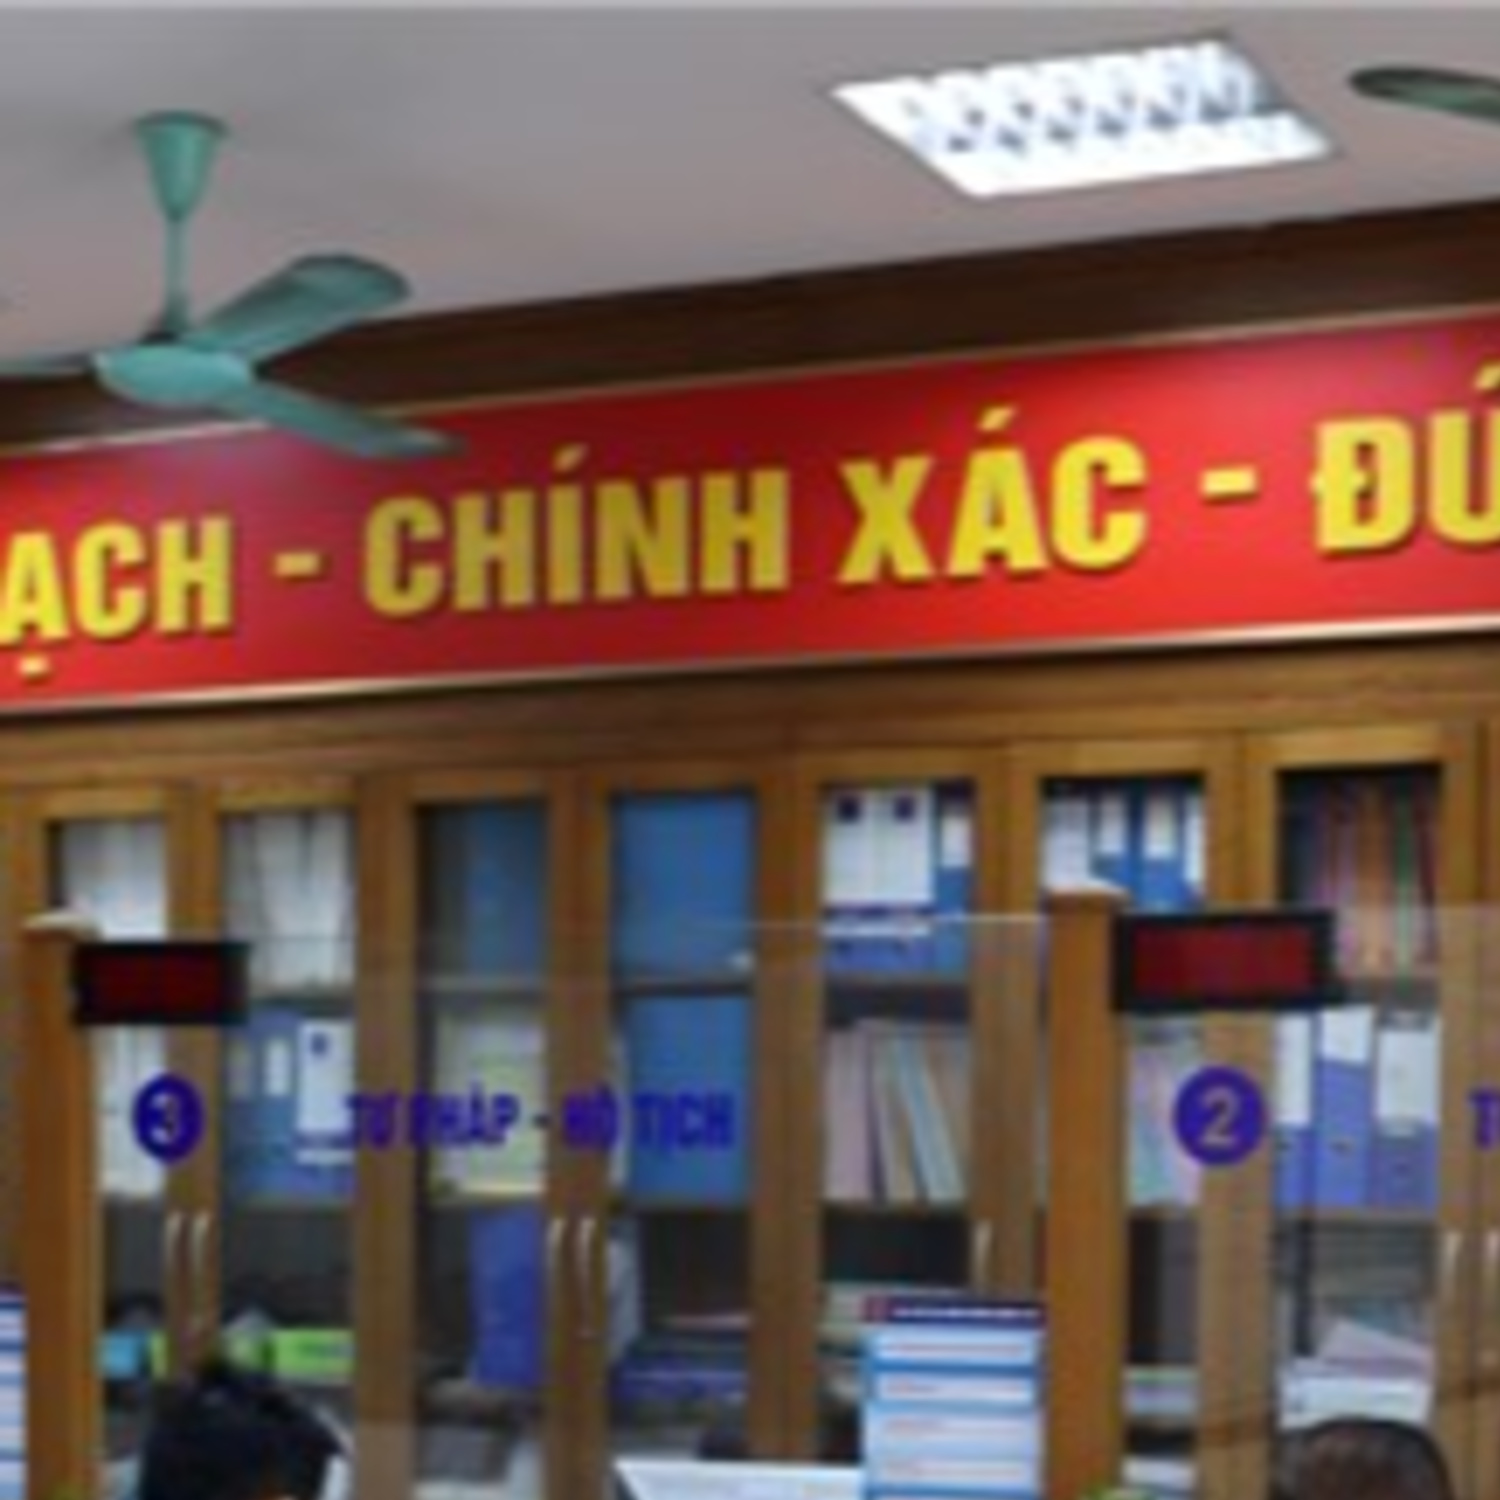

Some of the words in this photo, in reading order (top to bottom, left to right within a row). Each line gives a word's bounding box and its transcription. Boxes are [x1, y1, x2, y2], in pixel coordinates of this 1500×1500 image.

[0, 518, 233, 676] ẠCH
[272, 551, 321, 578] -
[363, 443, 788, 616] CHÍNH
[837, 405, 1147, 584] XÁC
[1203, 467, 1257, 498] -
[1199, 1085, 1240, 1148] 2
